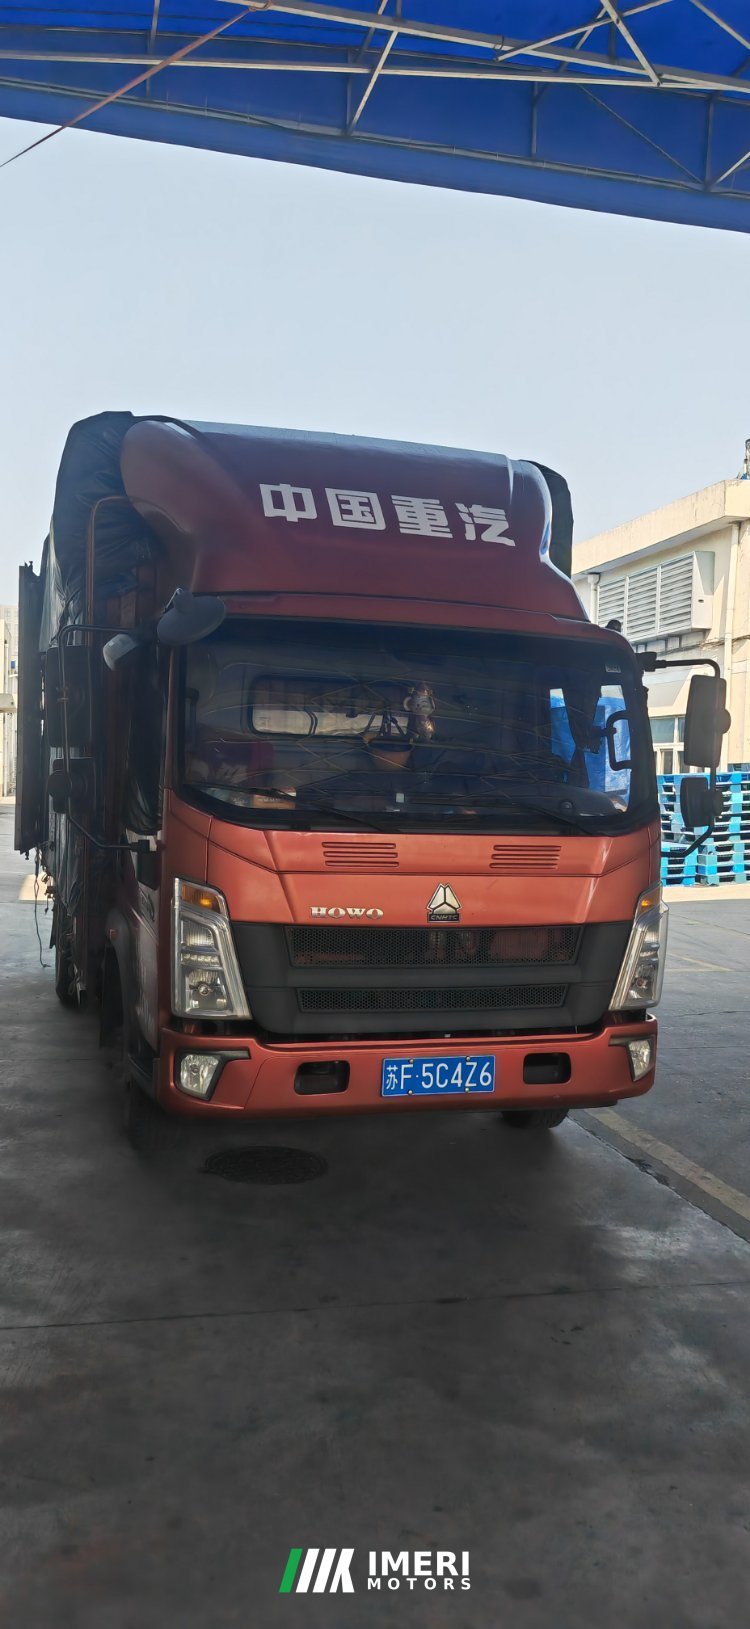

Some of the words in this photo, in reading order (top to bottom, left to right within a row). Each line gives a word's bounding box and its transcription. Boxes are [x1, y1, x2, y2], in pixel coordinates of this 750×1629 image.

[259, 483, 516, 547] 中国重汽
[310, 906, 384, 920] HOWO
